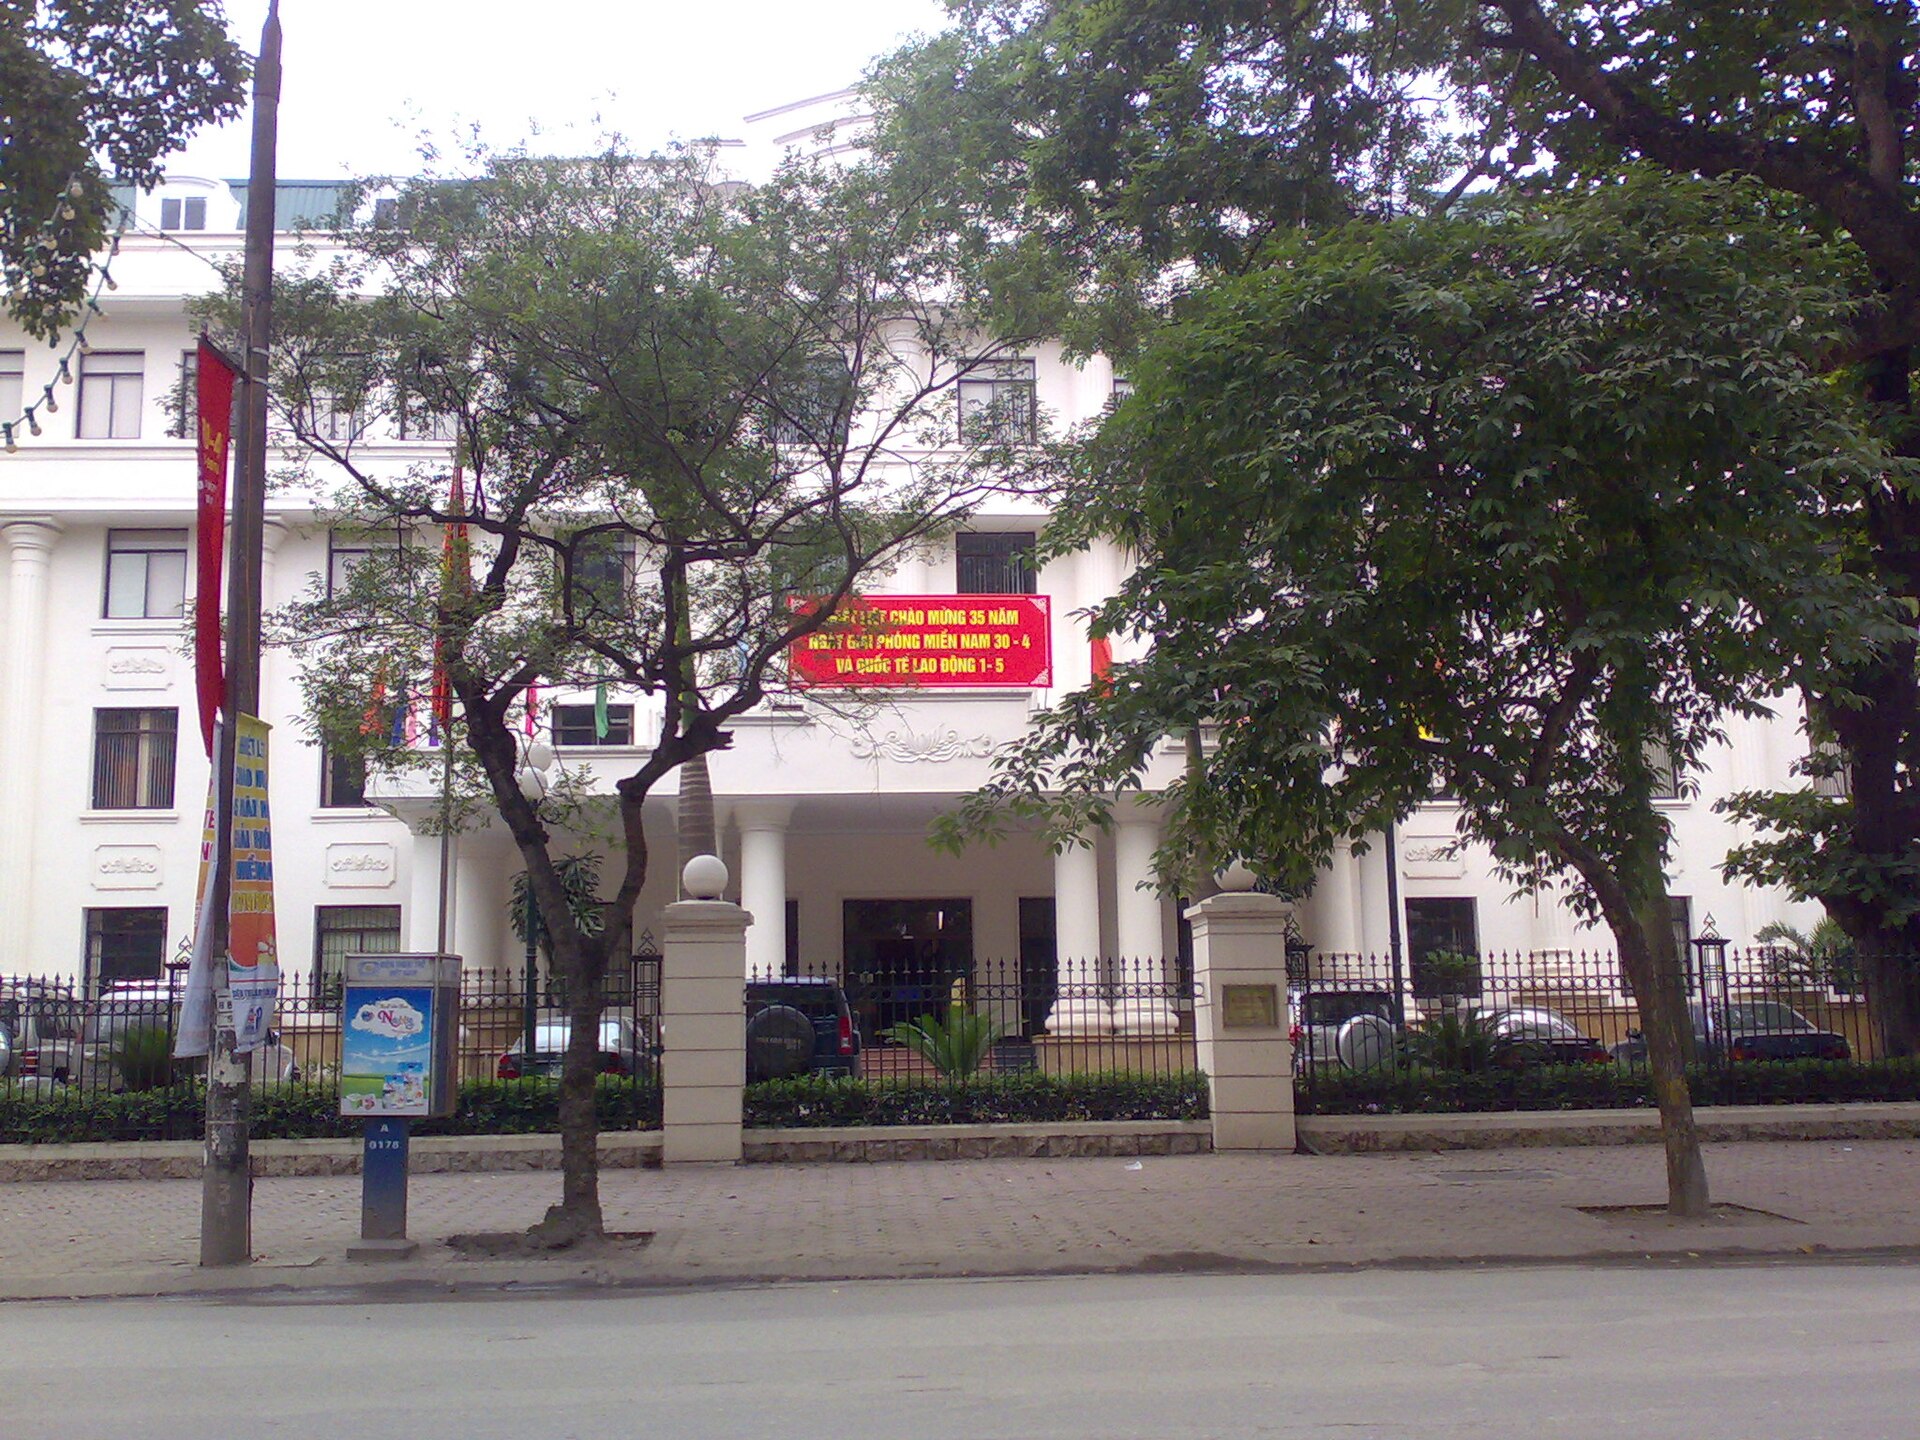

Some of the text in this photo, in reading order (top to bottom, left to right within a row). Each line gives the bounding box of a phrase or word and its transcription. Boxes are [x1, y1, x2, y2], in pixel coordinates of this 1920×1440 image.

[889, 606, 925, 625] CHÀO
[927, 605, 967, 625] MỪNG
[969, 609, 986, 625] 35
[988, 606, 1019, 625] NĂM
[876, 630, 921, 650] PHÓNG
[960, 633, 991, 650] NAM
[993, 633, 1011, 650] 30
[1021, 633, 1031, 650] 4
[835, 655, 854, 674] VÀ
[856, 653, 892, 675] QUỐC
[912, 657, 938, 674] LAO
[940, 654, 977, 677] ĐỘNG
[995, 657, 1005, 673] 5
[380, 1123, 389, 1133] A
